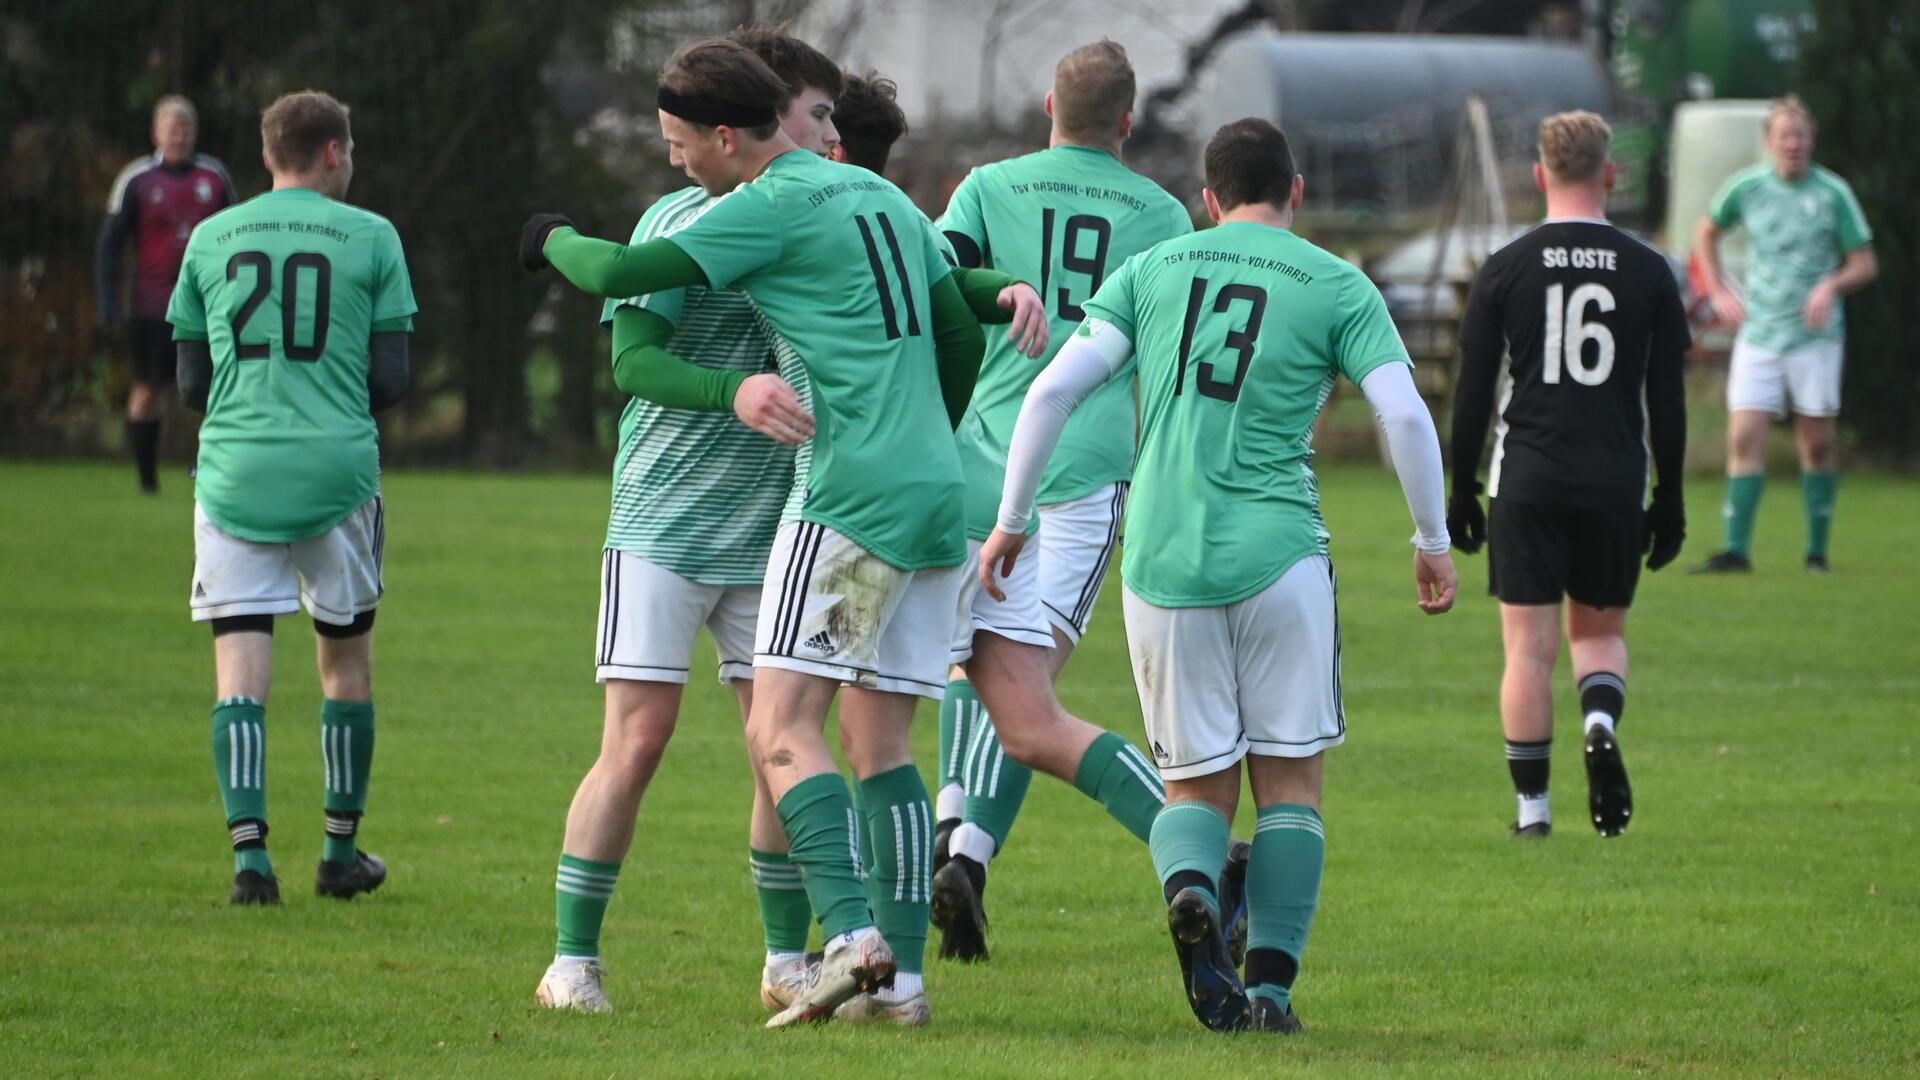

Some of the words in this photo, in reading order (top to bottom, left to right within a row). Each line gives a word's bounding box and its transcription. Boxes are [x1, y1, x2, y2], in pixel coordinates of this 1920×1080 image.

[808, 190, 825, 208] TSV
[1012, 184, 1030, 195] TSV
[1033, 181, 1147, 213] BASDAHL-VOLKMARST
[216, 230, 232, 246] TSV
[235, 221, 349, 244] BASDAHL-VOLKMARST
[854, 212, 921, 341] 11
[1041, 208, 1111, 323] 19
[1164, 252, 1184, 265] TSV
[1189, 250, 1313, 286] BASDAHL-VOLKMARST
[1542, 247, 1568, 268] SG
[1571, 247, 1617, 271] OSTE
[226, 251, 331, 363] 20
[1174, 276, 1268, 403] 13
[1542, 282, 1616, 386] 16
[804, 641, 835, 652] adidas
